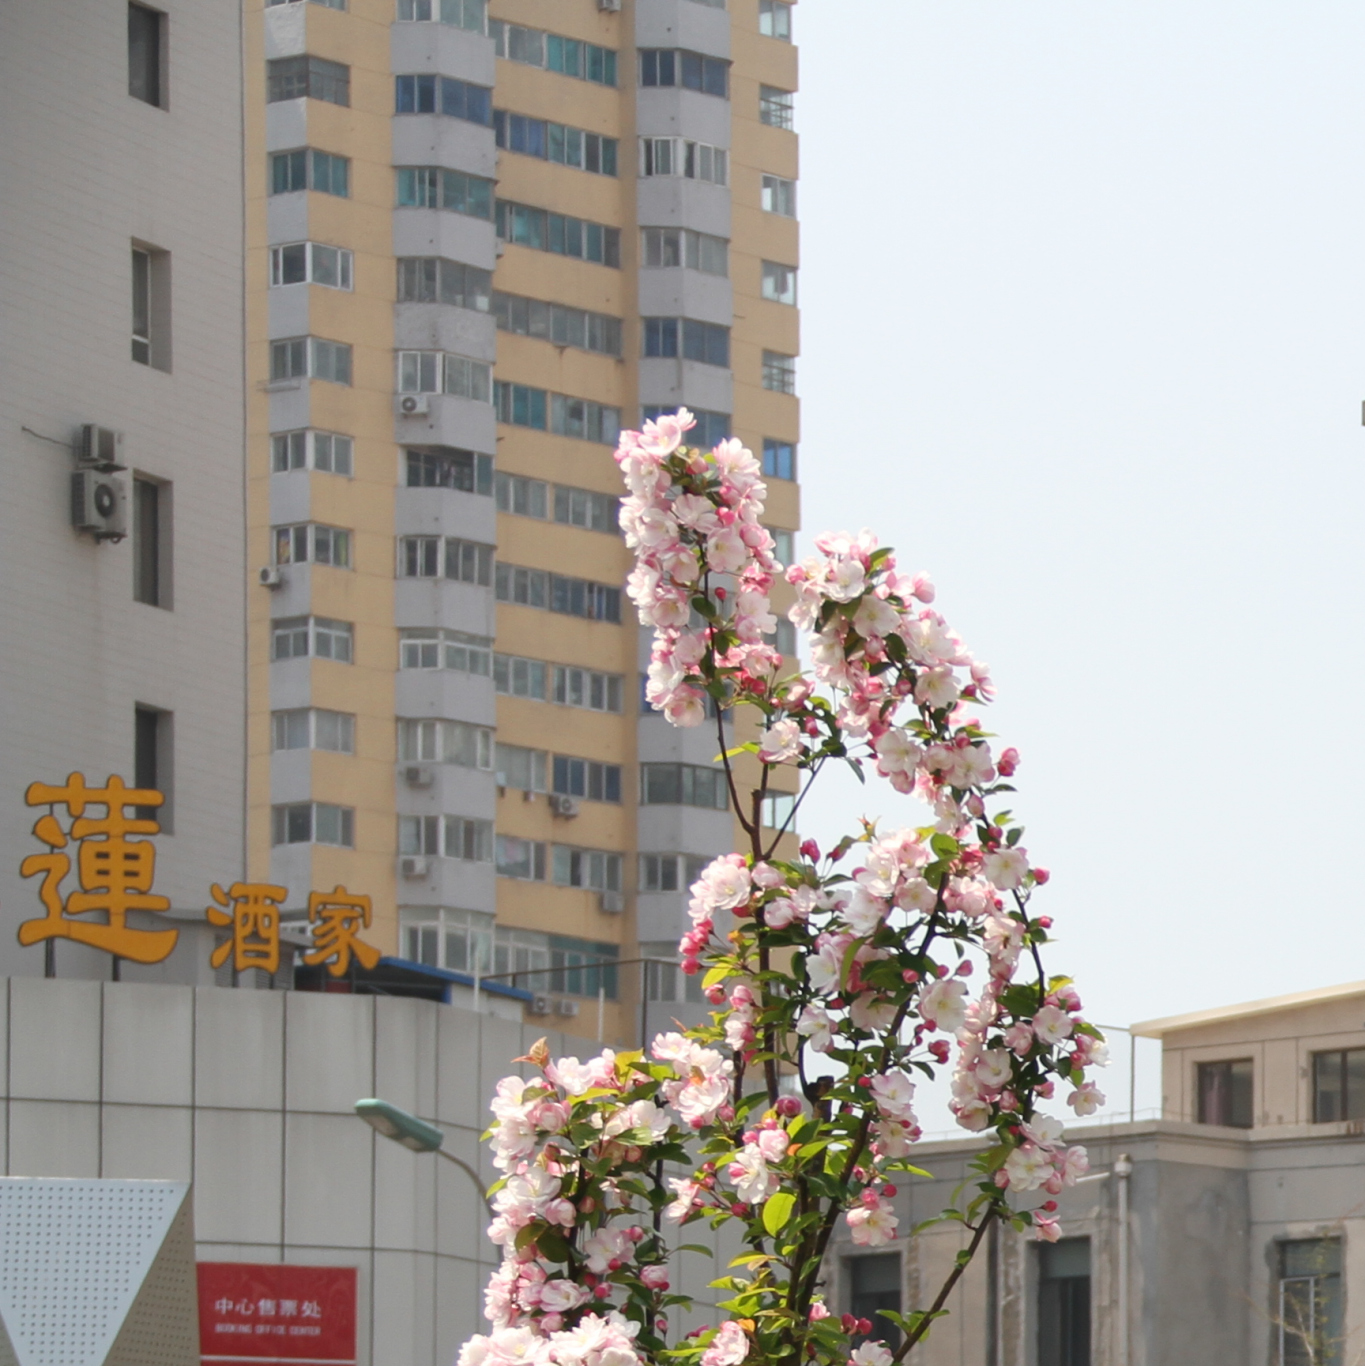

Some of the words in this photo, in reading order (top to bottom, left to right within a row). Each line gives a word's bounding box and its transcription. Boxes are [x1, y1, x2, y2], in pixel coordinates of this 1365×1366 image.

[214, 1297, 322, 1318] 中心售票处
